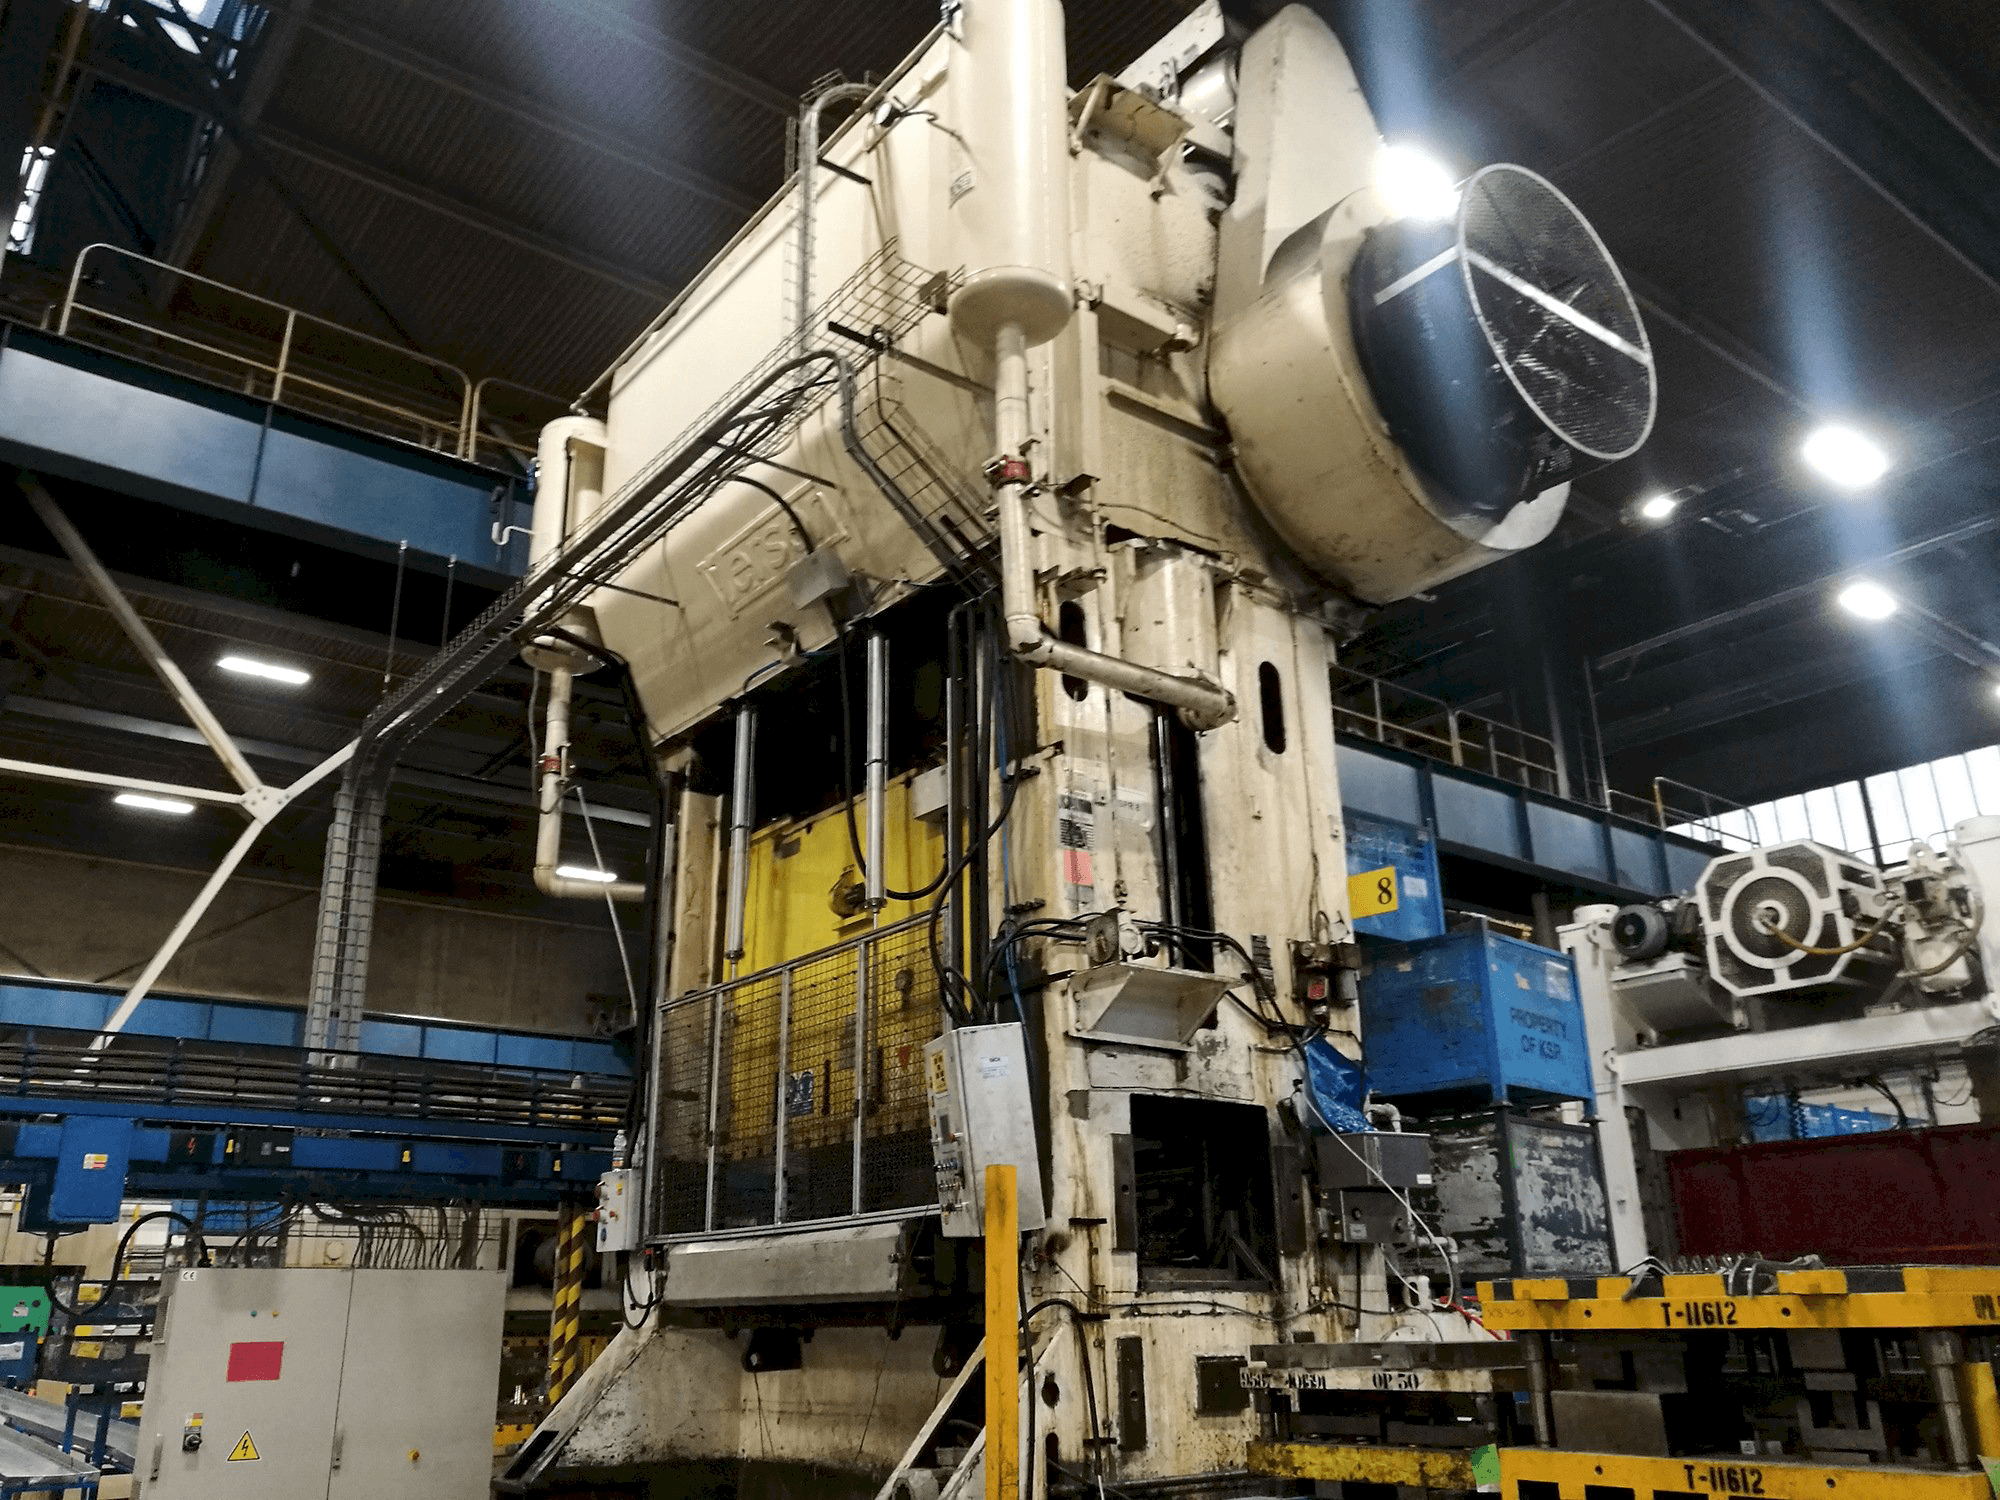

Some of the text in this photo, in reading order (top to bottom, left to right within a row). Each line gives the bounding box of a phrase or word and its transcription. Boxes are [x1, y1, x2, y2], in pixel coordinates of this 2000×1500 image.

[1377, 877, 1392, 905] 8
[1661, 1302, 1738, 1326] T-11612
[1372, 1373, 1393, 1389] OP
[1684, 1464, 1765, 1494] T-11612
